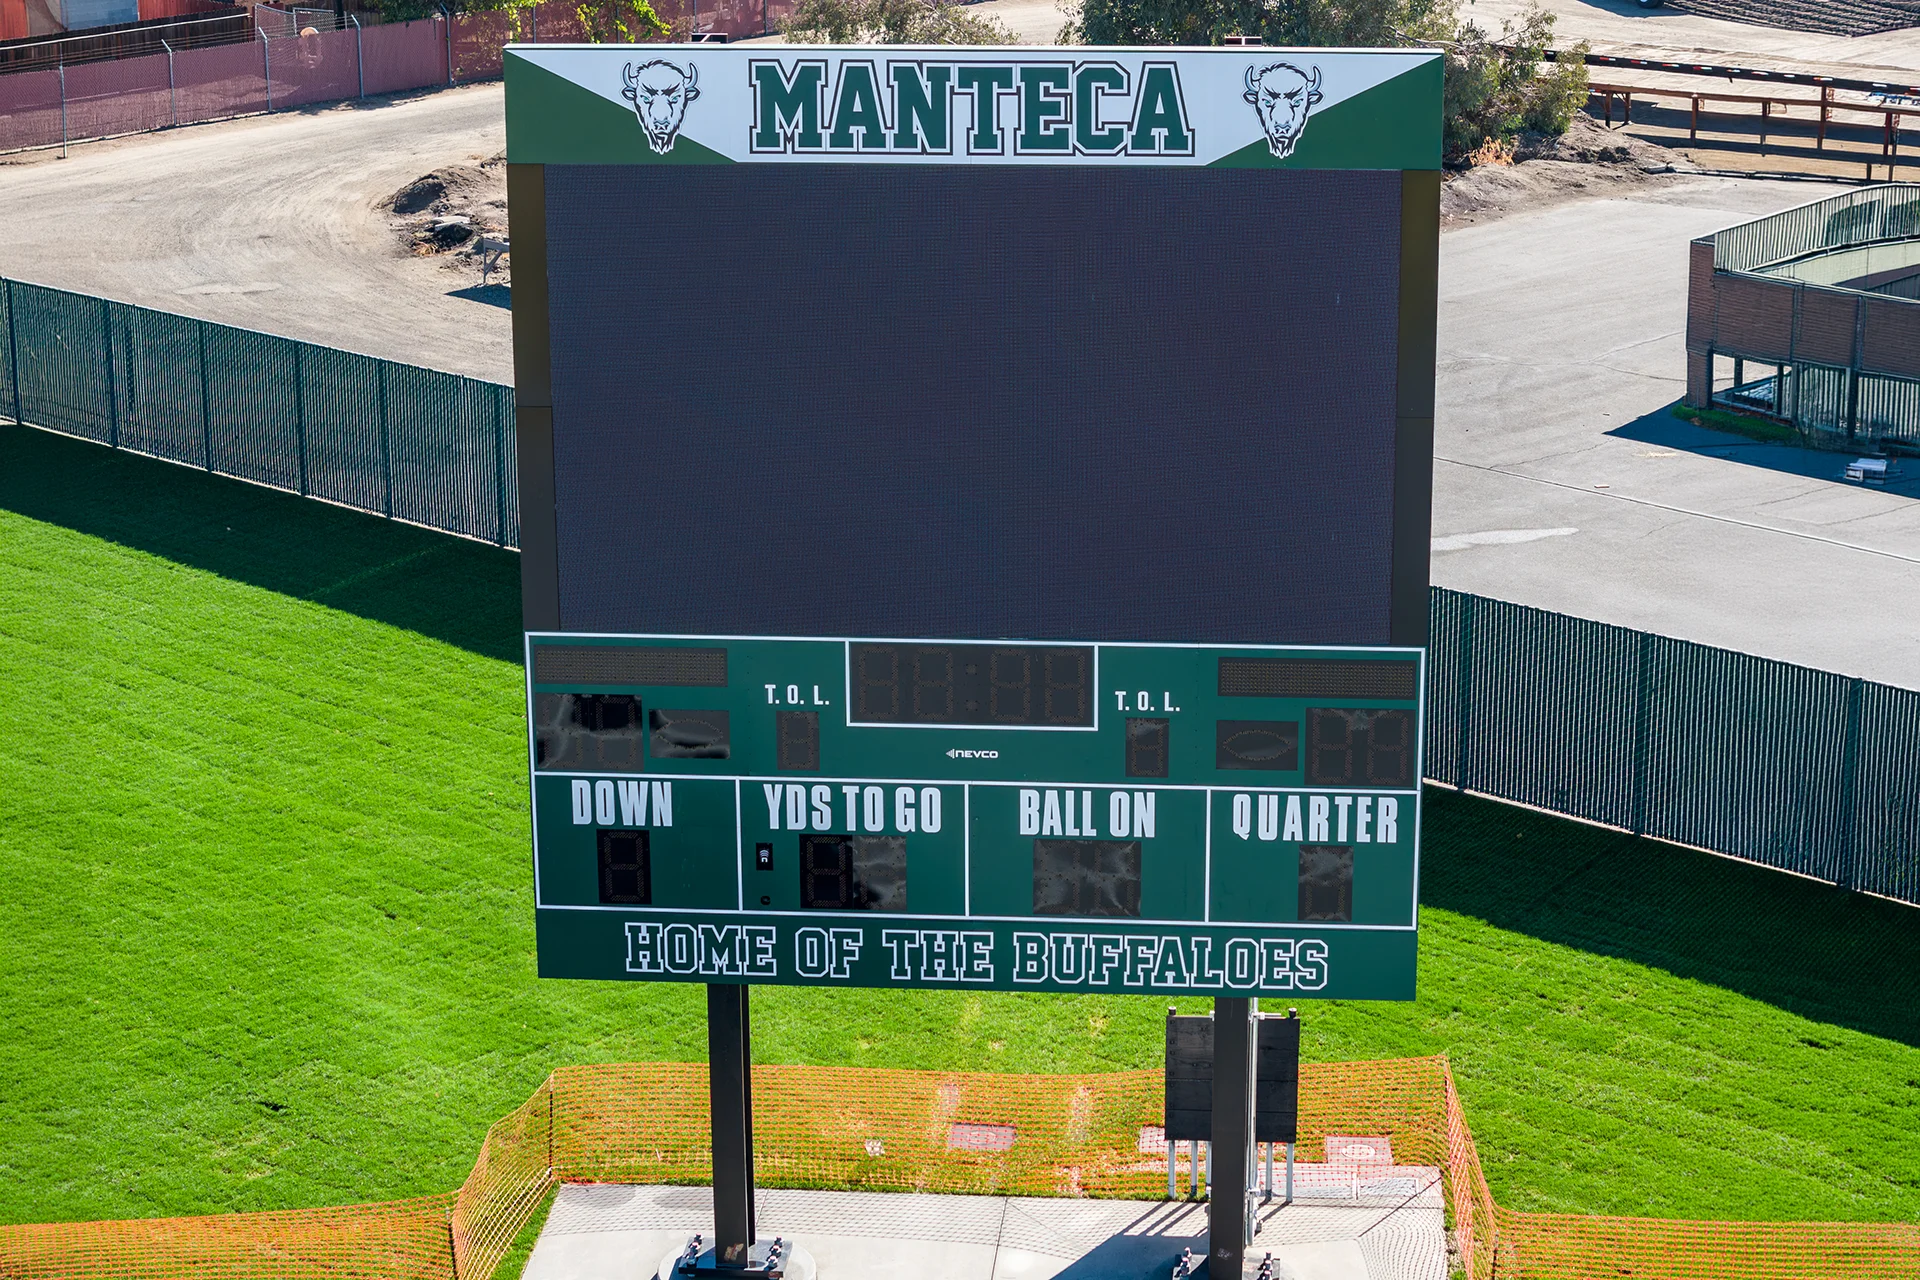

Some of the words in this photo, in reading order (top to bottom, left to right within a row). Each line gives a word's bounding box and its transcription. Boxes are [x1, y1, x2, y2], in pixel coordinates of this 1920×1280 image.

[748, 58, 1195, 157] MANTECA
[955, 749, 999, 759] NEVCO
[571, 779, 673, 827] DOWN
[762, 783, 832, 831] YDS
[842, 785, 884, 832] TO
[895, 786, 942, 833] GO
[1019, 788, 1097, 837] BALL
[1109, 791, 1156, 838] ON
[1232, 793, 1398, 844] QUARTER
[624, 922, 777, 977] HOME
[794, 927, 864, 979] OF
[882, 929, 994, 983] THE
[1012, 931, 1329, 991] BUFFALOES
